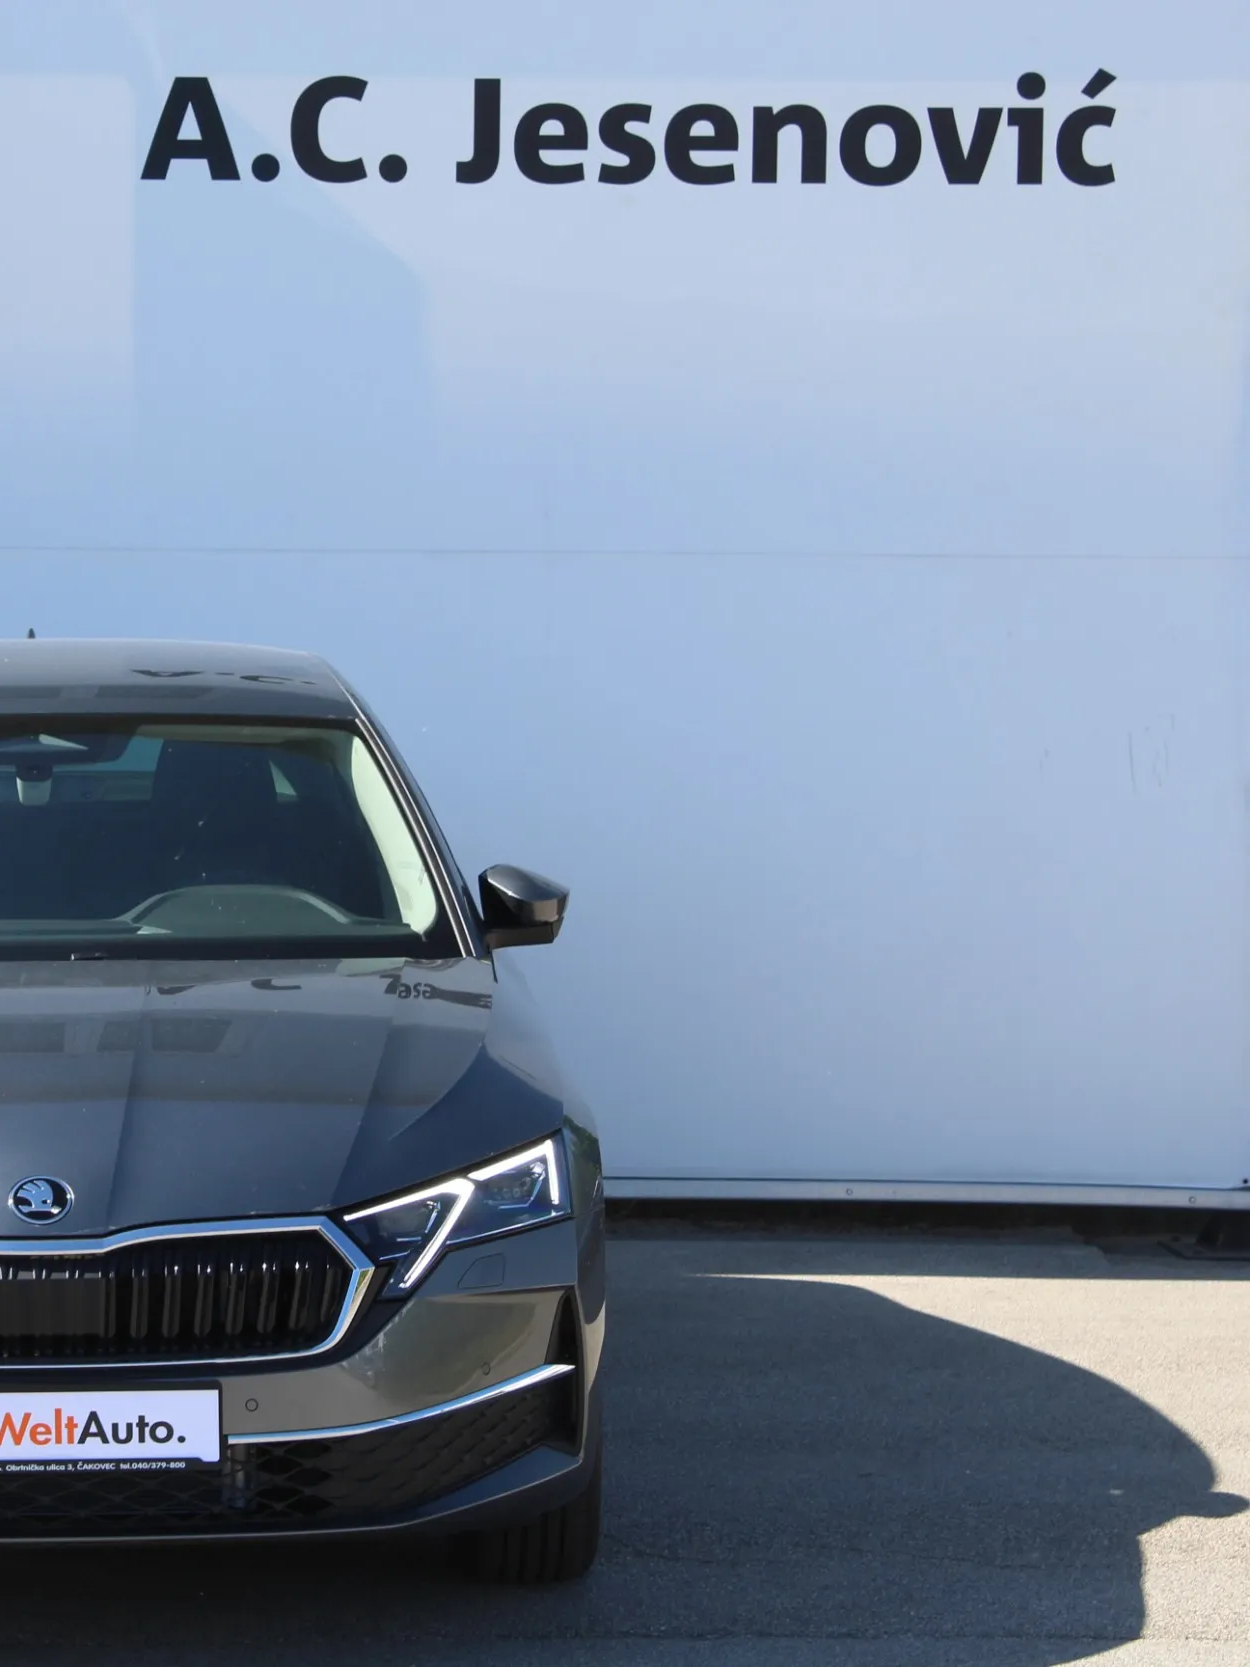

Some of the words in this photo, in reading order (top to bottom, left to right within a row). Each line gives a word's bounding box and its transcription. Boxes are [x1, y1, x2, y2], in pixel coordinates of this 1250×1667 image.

[140, 75, 408, 184] A.C.
[456, 68, 1118, 187] Jesenović
[5, 1463, 45, 1472] Obrtnička
[46, 1463, 66, 1471] ulica
[76, 1461, 116, 1471] ČAKOVEC
